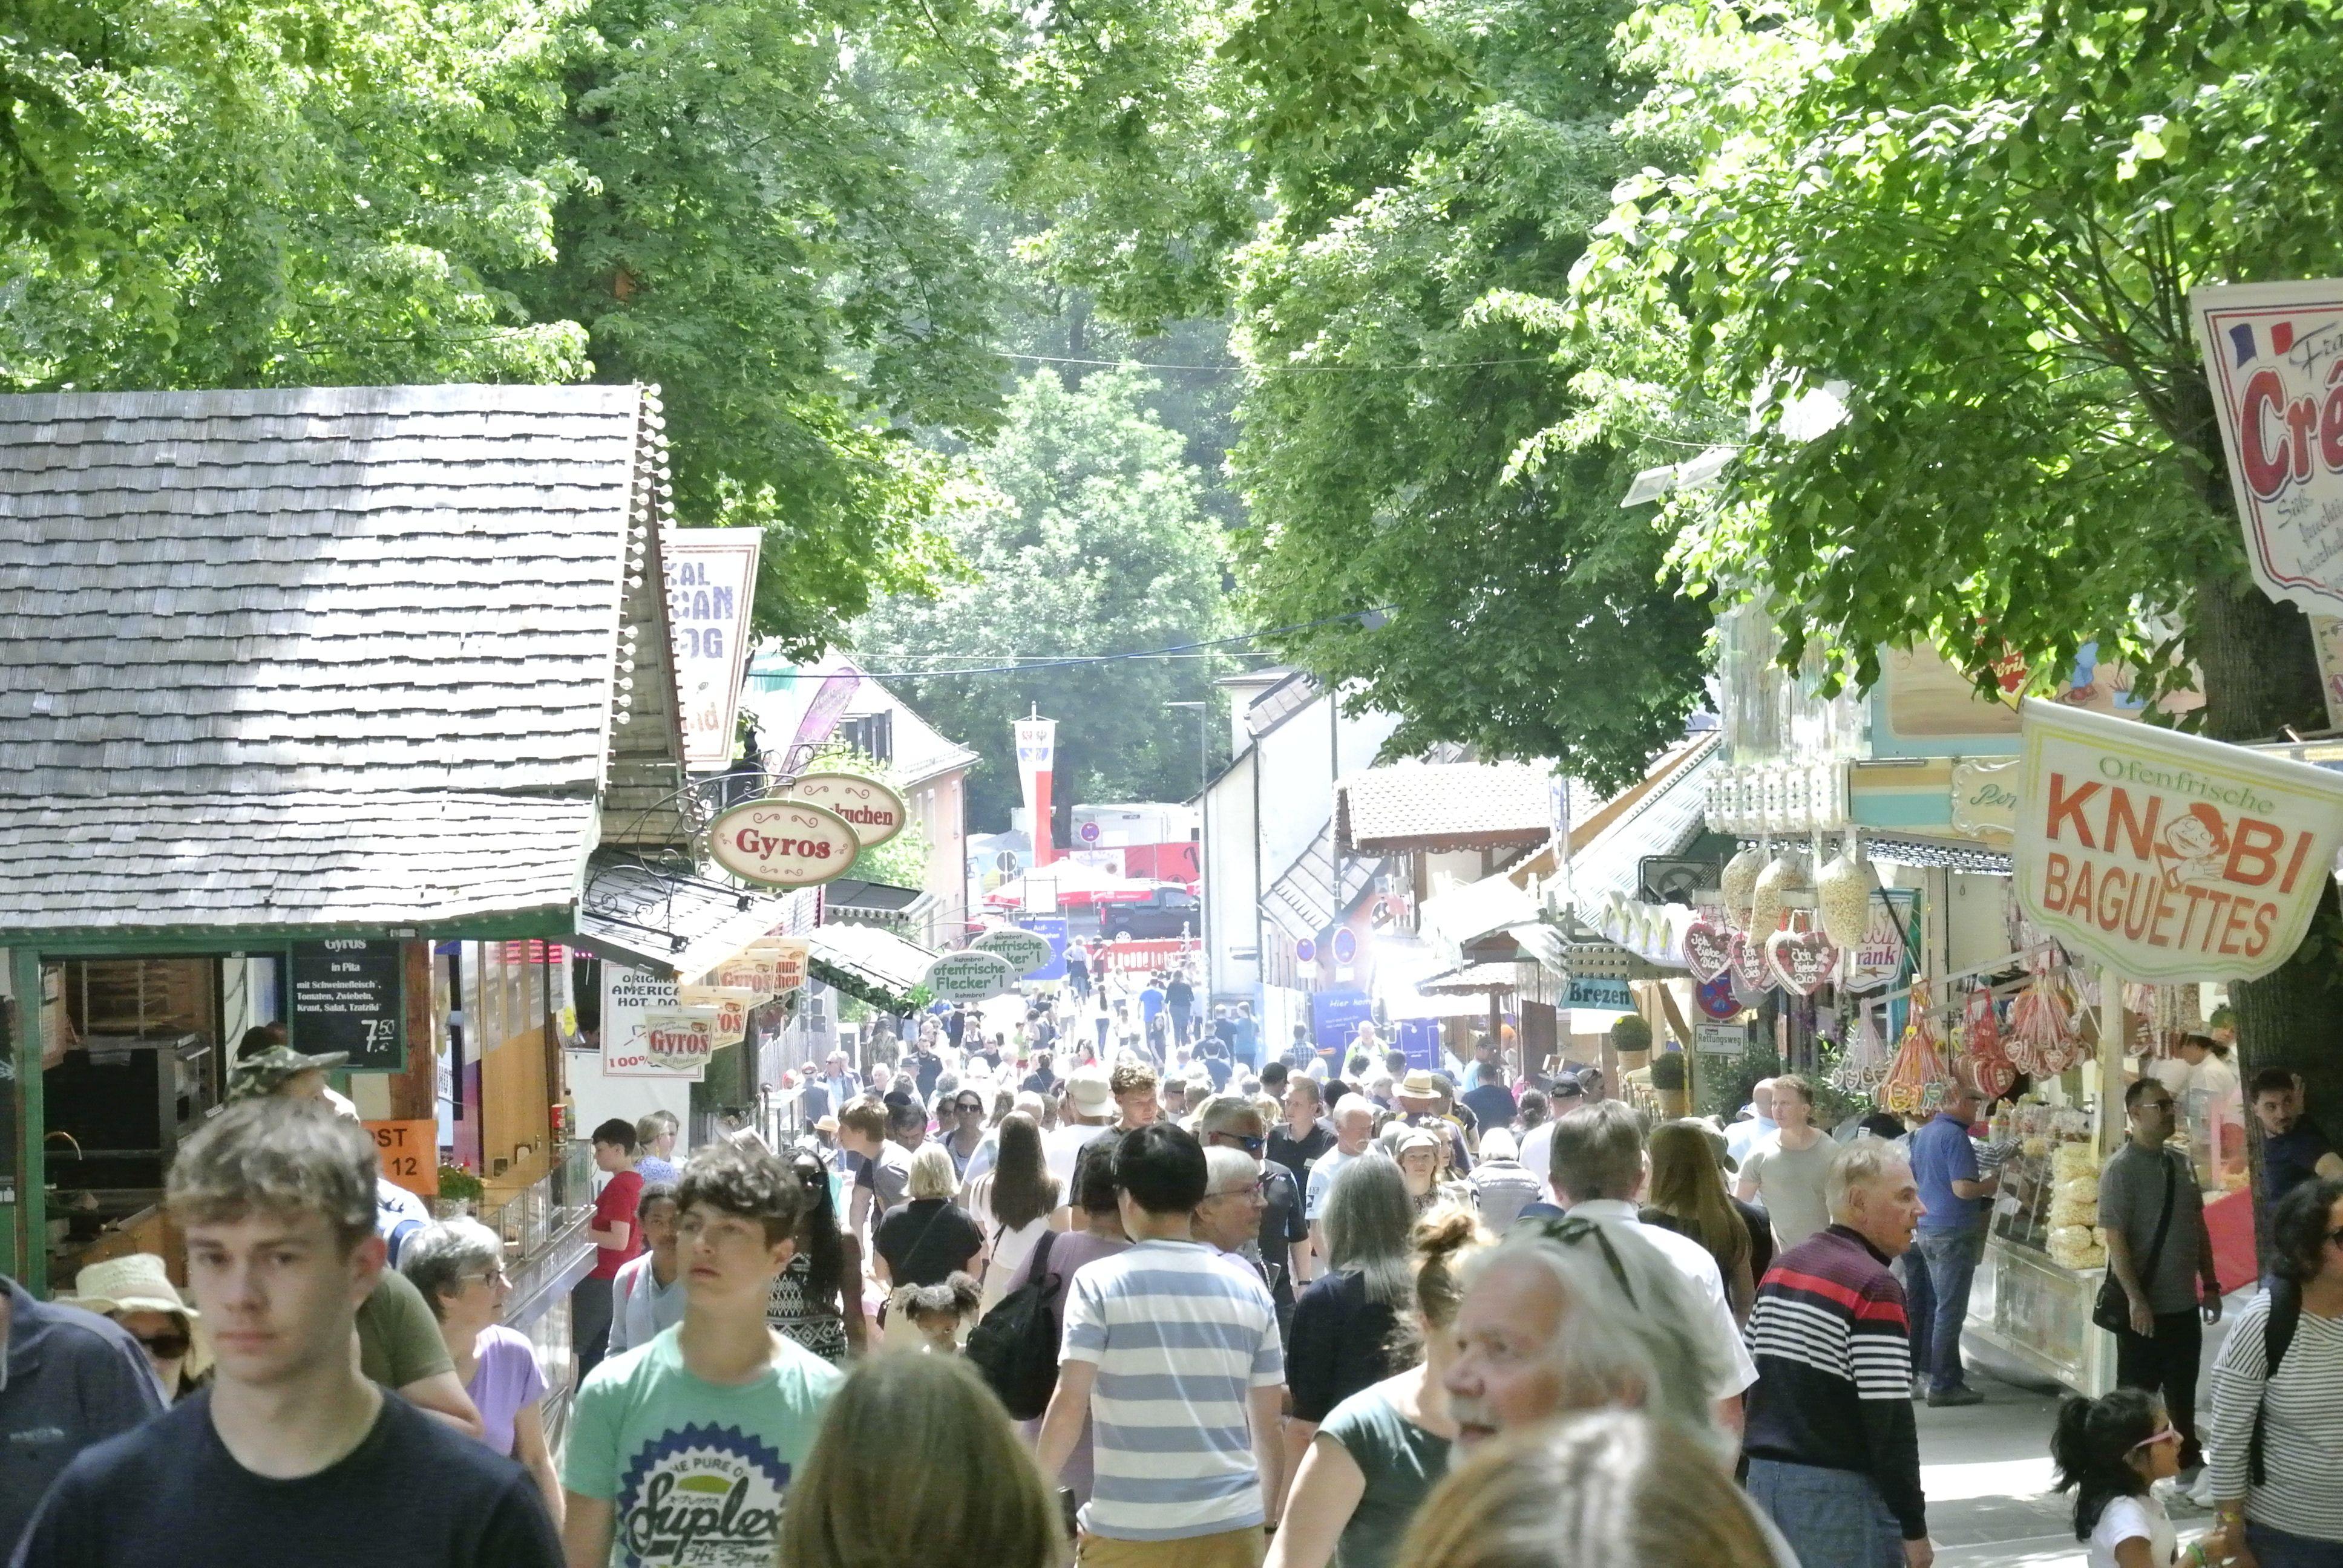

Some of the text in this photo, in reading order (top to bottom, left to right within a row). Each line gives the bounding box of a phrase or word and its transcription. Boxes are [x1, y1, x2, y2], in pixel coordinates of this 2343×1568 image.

[2099, 756, 2276, 815] Ofenfrische
[829, 803, 893, 826] kuchen
[736, 828, 831, 860] Gyros
[2043, 852, 2279, 958] BAGUETTES
[1691, 933, 1710, 947] Ich
[1792, 948, 1814, 962] Ich
[331, 962, 360, 972] in Pita
[934, 962, 1006, 976] ofenfrische
[1794, 961, 1818, 973] liebe
[1795, 973, 1817, 984] Dich
[297, 992, 333, 1001] Tomaten,
[1569, 982, 1630, 1005] Brezen
[297, 1004, 322, 1012] Kraut,
[324, 1004, 347, 1012] Salat,
[618, 998, 648, 1007] HOT
[650, 1030, 709, 1057] Gyros
[1698, 1033, 1742, 1047] Rettungsweg
[392, 1157, 416, 1176] 12
